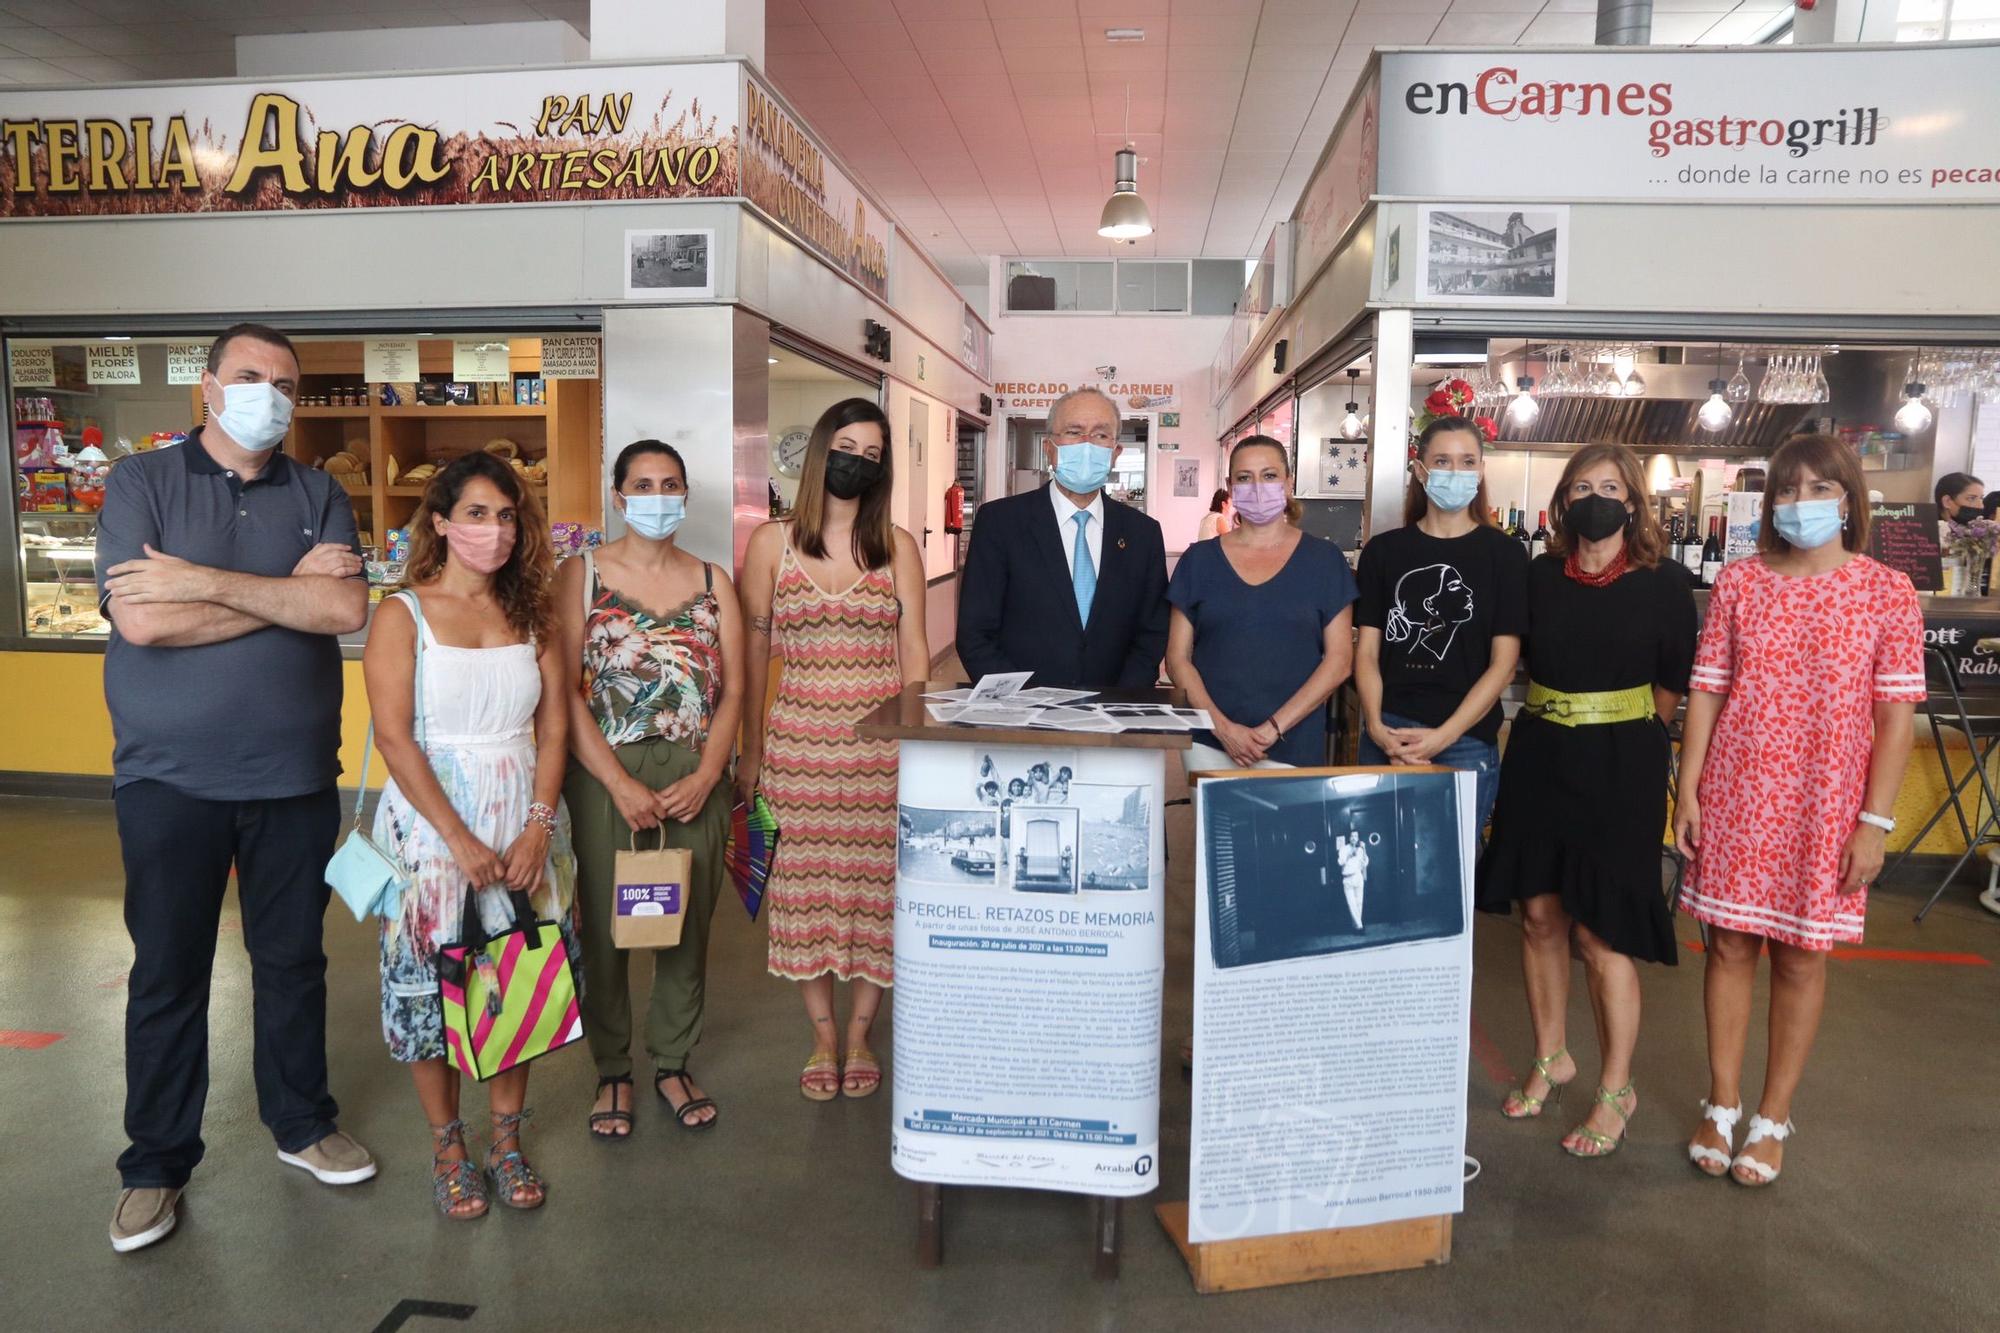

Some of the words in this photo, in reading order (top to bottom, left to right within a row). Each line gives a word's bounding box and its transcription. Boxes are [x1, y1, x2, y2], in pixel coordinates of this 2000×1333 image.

[1404, 67, 1673, 119] enCarnes
[537, 91, 632, 136] PAN
[747, 79, 826, 194] PANADERIA
[1647, 107, 1882, 158] gastrogrill
[2, 117, 201, 194] TERIA
[223, 93, 451, 193] Ana
[471, 145, 719, 191] ARTESANO
[1678, 164, 1751, 184] donde
[1760, 164, 1777, 184] la
[1786, 169, 1850, 184] carne
[1860, 169, 1889, 184] no
[1898, 169, 1922, 184] es
[777, 173, 848, 266] CONFITERIA
[851, 198, 886, 280] Ana
[543, 338, 562, 346] PAN
[564, 337, 598, 346] CATETO
[12, 350, 51, 358] ODUCTOS
[88, 347, 118, 357] MIEL
[122, 346, 134, 356] DE
[168, 346, 187, 355] PAN
[93, 371, 104, 380] DE
[106, 371, 136, 380] ALORA
[995, 383, 1068, 394] MERCADO
[1108, 384, 1174, 396] CARMEN
[1012, 398, 1057, 407] CAFET
[1869, 504, 1914, 519] astrogrill
[1923, 627, 1960, 644] ott
[1959, 658, 2000, 674] Rab
[623, 888, 650, 900] 100%
[985, 906, 1054, 923] RETAZOS
[1059, 910, 1080, 924] DE
[1085, 910, 1155, 926] MEMORIA
[922, 921, 944, 930] partir
[946, 922, 956, 930] de
[980, 924, 1000, 932] fotos
[1038, 928, 1077, 936] ANTONIO
[1079, 929, 1124, 938] BERROCAL
[1001, 940, 1017, 950] julio
[1028, 943, 1044, 952] 2021
[1052, 944, 1064, 952] las
[1085, 946, 1106, 954] horas
[951, 1112, 986, 1122] Mercado
[987, 1115, 1026, 1126] Municipal
[1027, 1118, 1038, 1126] de
[1040, 1116, 1048, 1126] El
[1049, 1118, 1081, 1128] Carmen
[922, 1122, 931, 1130] 20
[985, 1128, 1023, 1136] septiembre
[1104, 1134, 1124, 1143] horas
[1095, 1162, 1133, 1173] Arrabal
[1346, 1196, 1378, 1206] Antonio
[1379, 1190, 1412, 1202] Berrocal
[1414, 1184, 1453, 1196] 1950-2020
